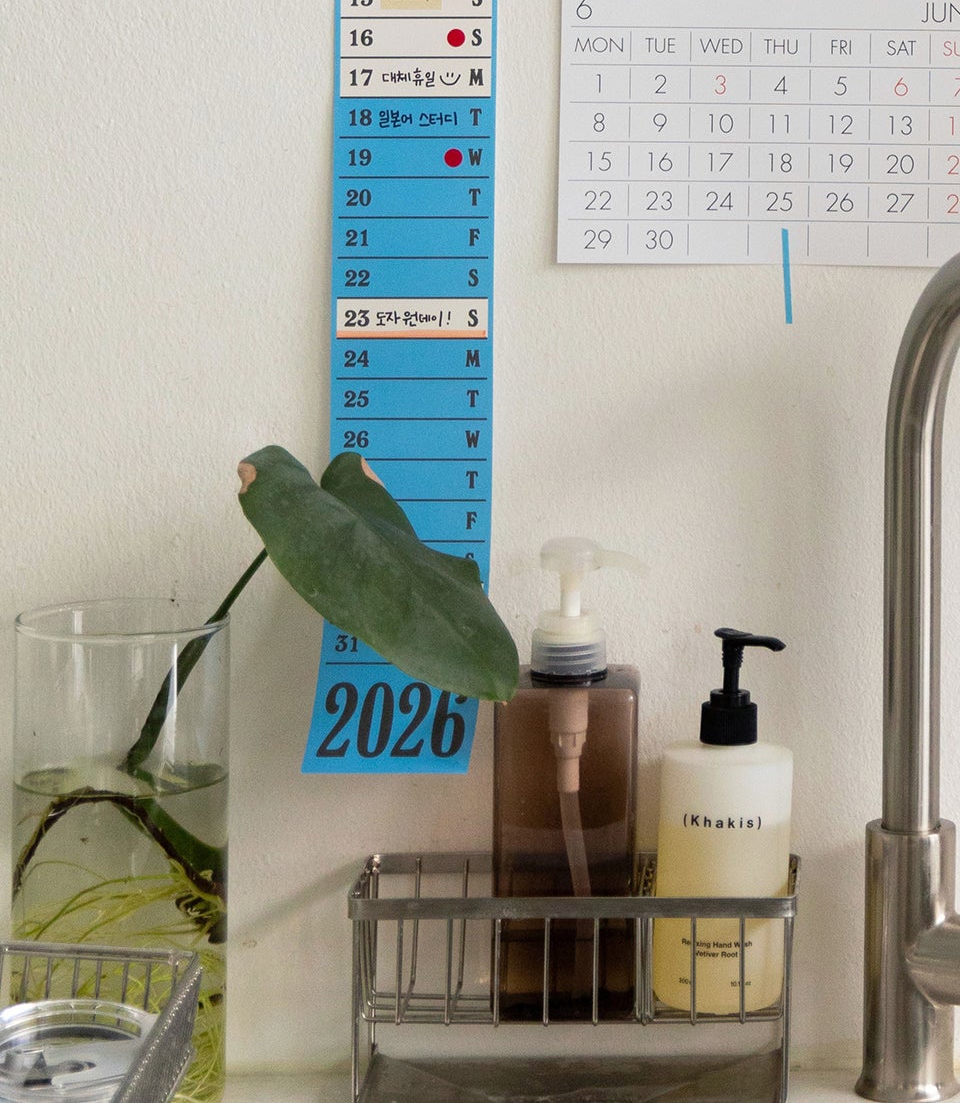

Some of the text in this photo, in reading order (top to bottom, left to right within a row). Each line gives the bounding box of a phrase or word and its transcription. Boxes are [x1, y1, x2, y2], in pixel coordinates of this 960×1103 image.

[349, 28, 374, 47] 16
[471, 28, 483, 47] S
[574, 36, 624, 54] MON
[644, 37, 676, 54] TUE
[699, 38, 744, 55] WED
[763, 38, 799, 55] THU
[830, 39, 852, 56] FRI
[886, 39, 917, 57] SAT
[349, 68, 374, 87] 17
[468, 68, 484, 87] M
[596, 73, 602, 94] 1
[654, 73, 667, 95] 2
[714, 74, 727, 95] 3
[773, 75, 788, 95] 4
[833, 75, 848, 97] 5
[893, 77, 909, 97] 6
[348, 108, 373, 127] 18
[379, 110, 458, 128] 일본어 스터디
[469, 107, 483, 127] T
[593, 112, 606, 133] 8
[652, 112, 668, 133] 9
[708, 113, 734, 134] 10
[769, 113, 790, 134] 11
[829, 114, 854, 135] 12
[888, 115, 913, 136] 13
[348, 148, 372, 167] 19
[467, 148, 483, 167] W
[587, 151, 612, 172] 15
[648, 151, 674, 172] 16
[708, 152, 734, 173] 17
[768, 152, 793, 174] 18
[828, 153, 854, 174] 19
[886, 153, 915, 175] 20
[345, 188, 372, 207] 20
[468, 188, 482, 207] T
[584, 190, 612, 211] 22
[646, 190, 673, 211] 23
[706, 190, 734, 212] 24
[766, 191, 793, 212] 25
[826, 191, 854, 213] 26
[886, 192, 915, 213] 27
[345, 228, 369, 247] 21
[469, 228, 481, 247] F
[583, 229, 674, 251] 29 30
[344, 269, 371, 288] 22
[467, 268, 480, 288] S
[343, 309, 370, 328] 23
[467, 308, 479, 328] S
[343, 349, 370, 368] 24
[465, 349, 481, 368] M
[343, 389, 370, 409] 25
[466, 389, 480, 408] T
[342, 430, 370, 449] 26
[464, 429, 481, 449] W
[465, 470, 479, 490] T
[465, 511, 478, 530] F
[334, 633, 359, 653] 31
[316, 681, 467, 758] 2026
[683, 813, 762, 830] (Khakis)
[681, 938, 712, 949] Rexing
[712, 941, 733, 949] Hand
